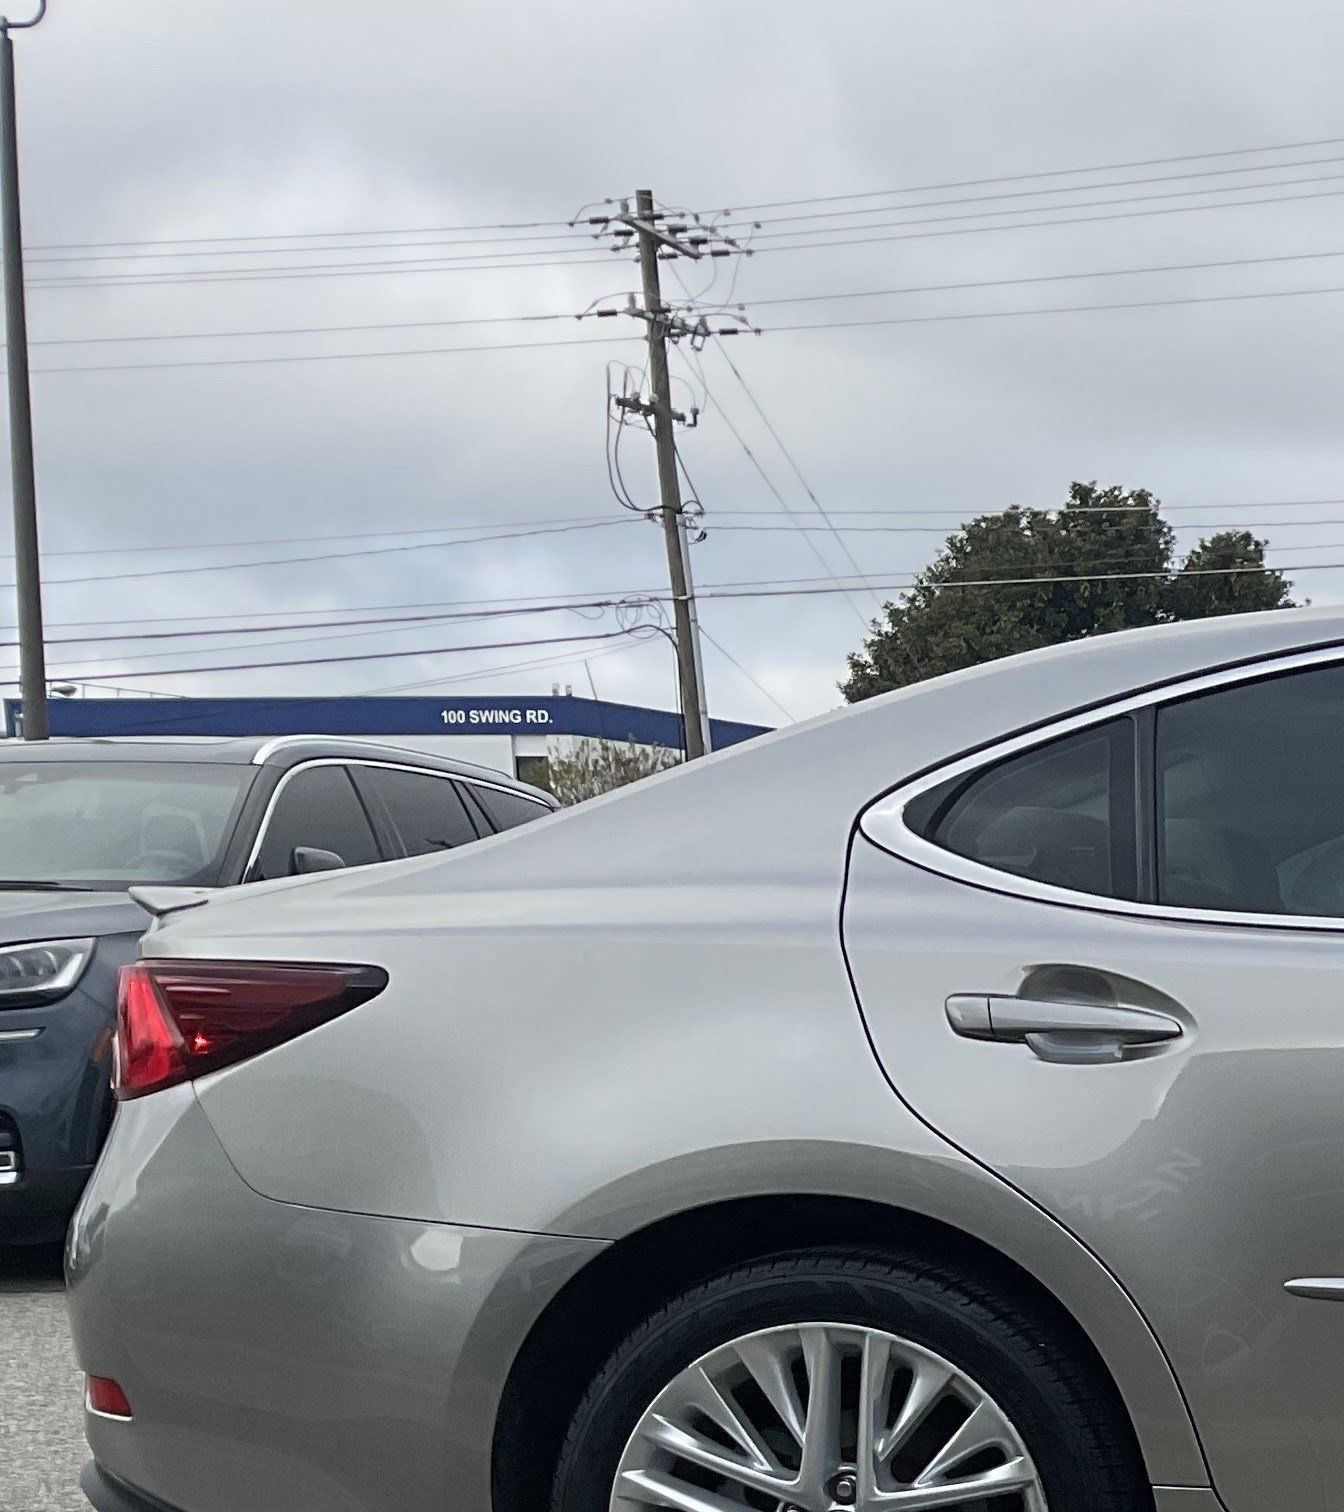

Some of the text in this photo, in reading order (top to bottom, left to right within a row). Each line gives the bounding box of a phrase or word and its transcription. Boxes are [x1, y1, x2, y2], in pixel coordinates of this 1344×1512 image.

[441, 710, 554, 724] 100 SWING RD.
